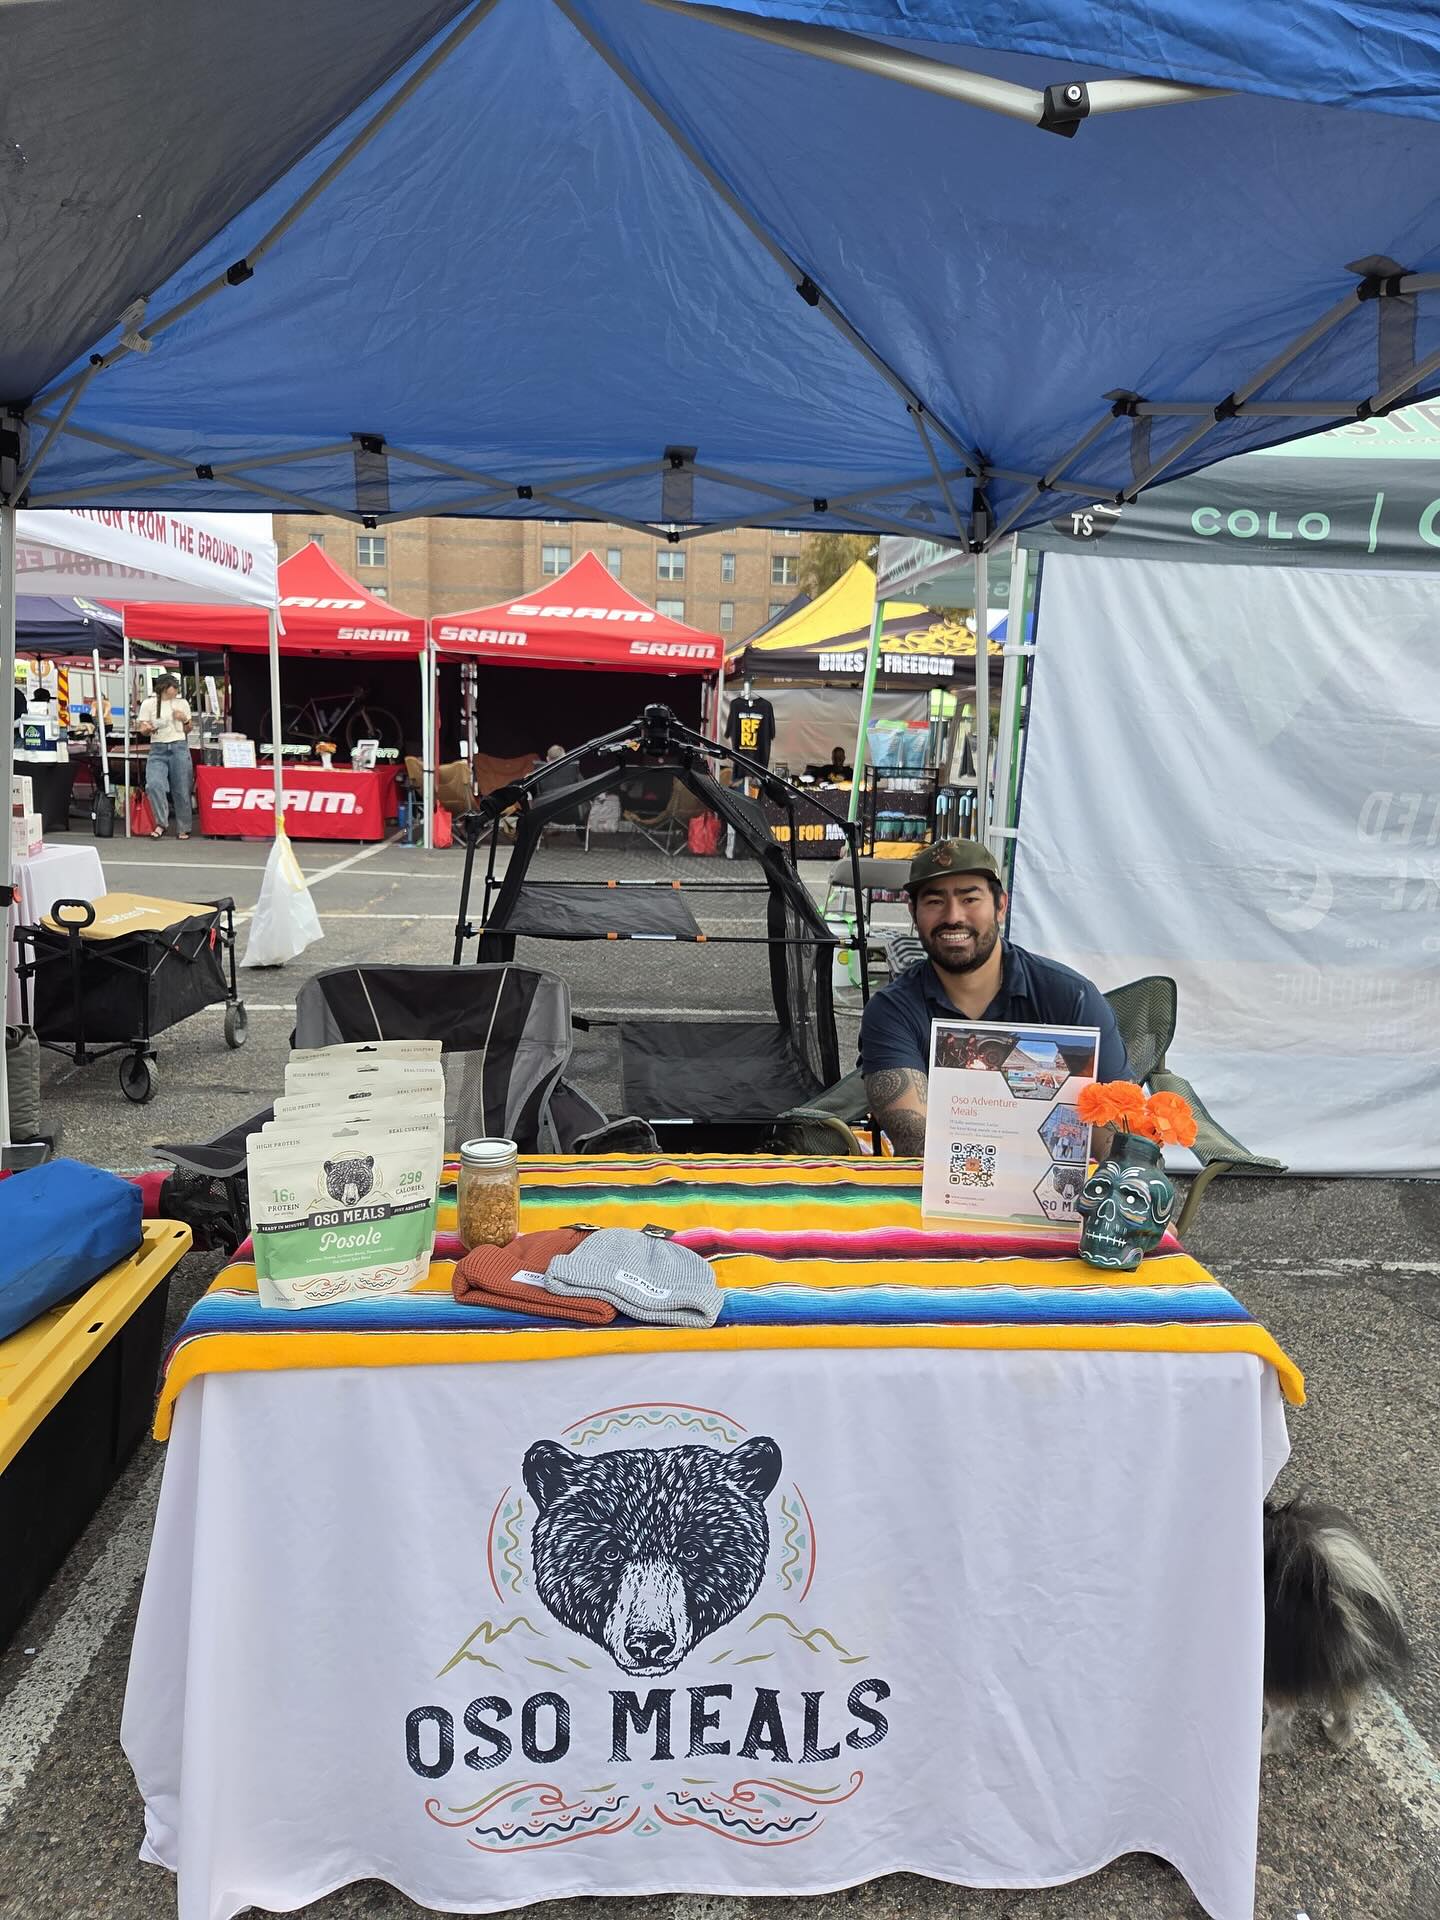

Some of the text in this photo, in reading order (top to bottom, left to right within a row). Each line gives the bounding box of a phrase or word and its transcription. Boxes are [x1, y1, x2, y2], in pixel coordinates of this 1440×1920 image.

[1191, 506, 1331, 541] COLO
[128, 510, 167, 544] FROM
[171, 519, 194, 555] THE
[199, 531, 239, 570] GROUND
[242, 549, 253, 575] UP
[507, 604, 655, 623] SRAM
[337, 627, 410, 642] SRAM
[439, 626, 716, 659] SRAM SRAM
[818, 653, 955, 676] BIKES FREEDOM
[741, 719, 760, 733] RF
[211, 787, 357, 815] SRAM
[799, 824, 825, 841] FOR
[951, 1095, 1018, 1108] Oso Adventure
[951, 1106, 978, 1117] Meals
[273, 1139, 301, 1148] PROTEIN
[395, 1184, 425, 1195] CALORIES
[267, 1203, 300, 1212] PROTEIN
[314, 1206, 385, 1227] OSO MEALS
[318, 1226, 382, 1252] Posole
[623, 1272, 665, 1295] OSO MEALS
[405, 1678, 891, 1780] OSO MEALS
